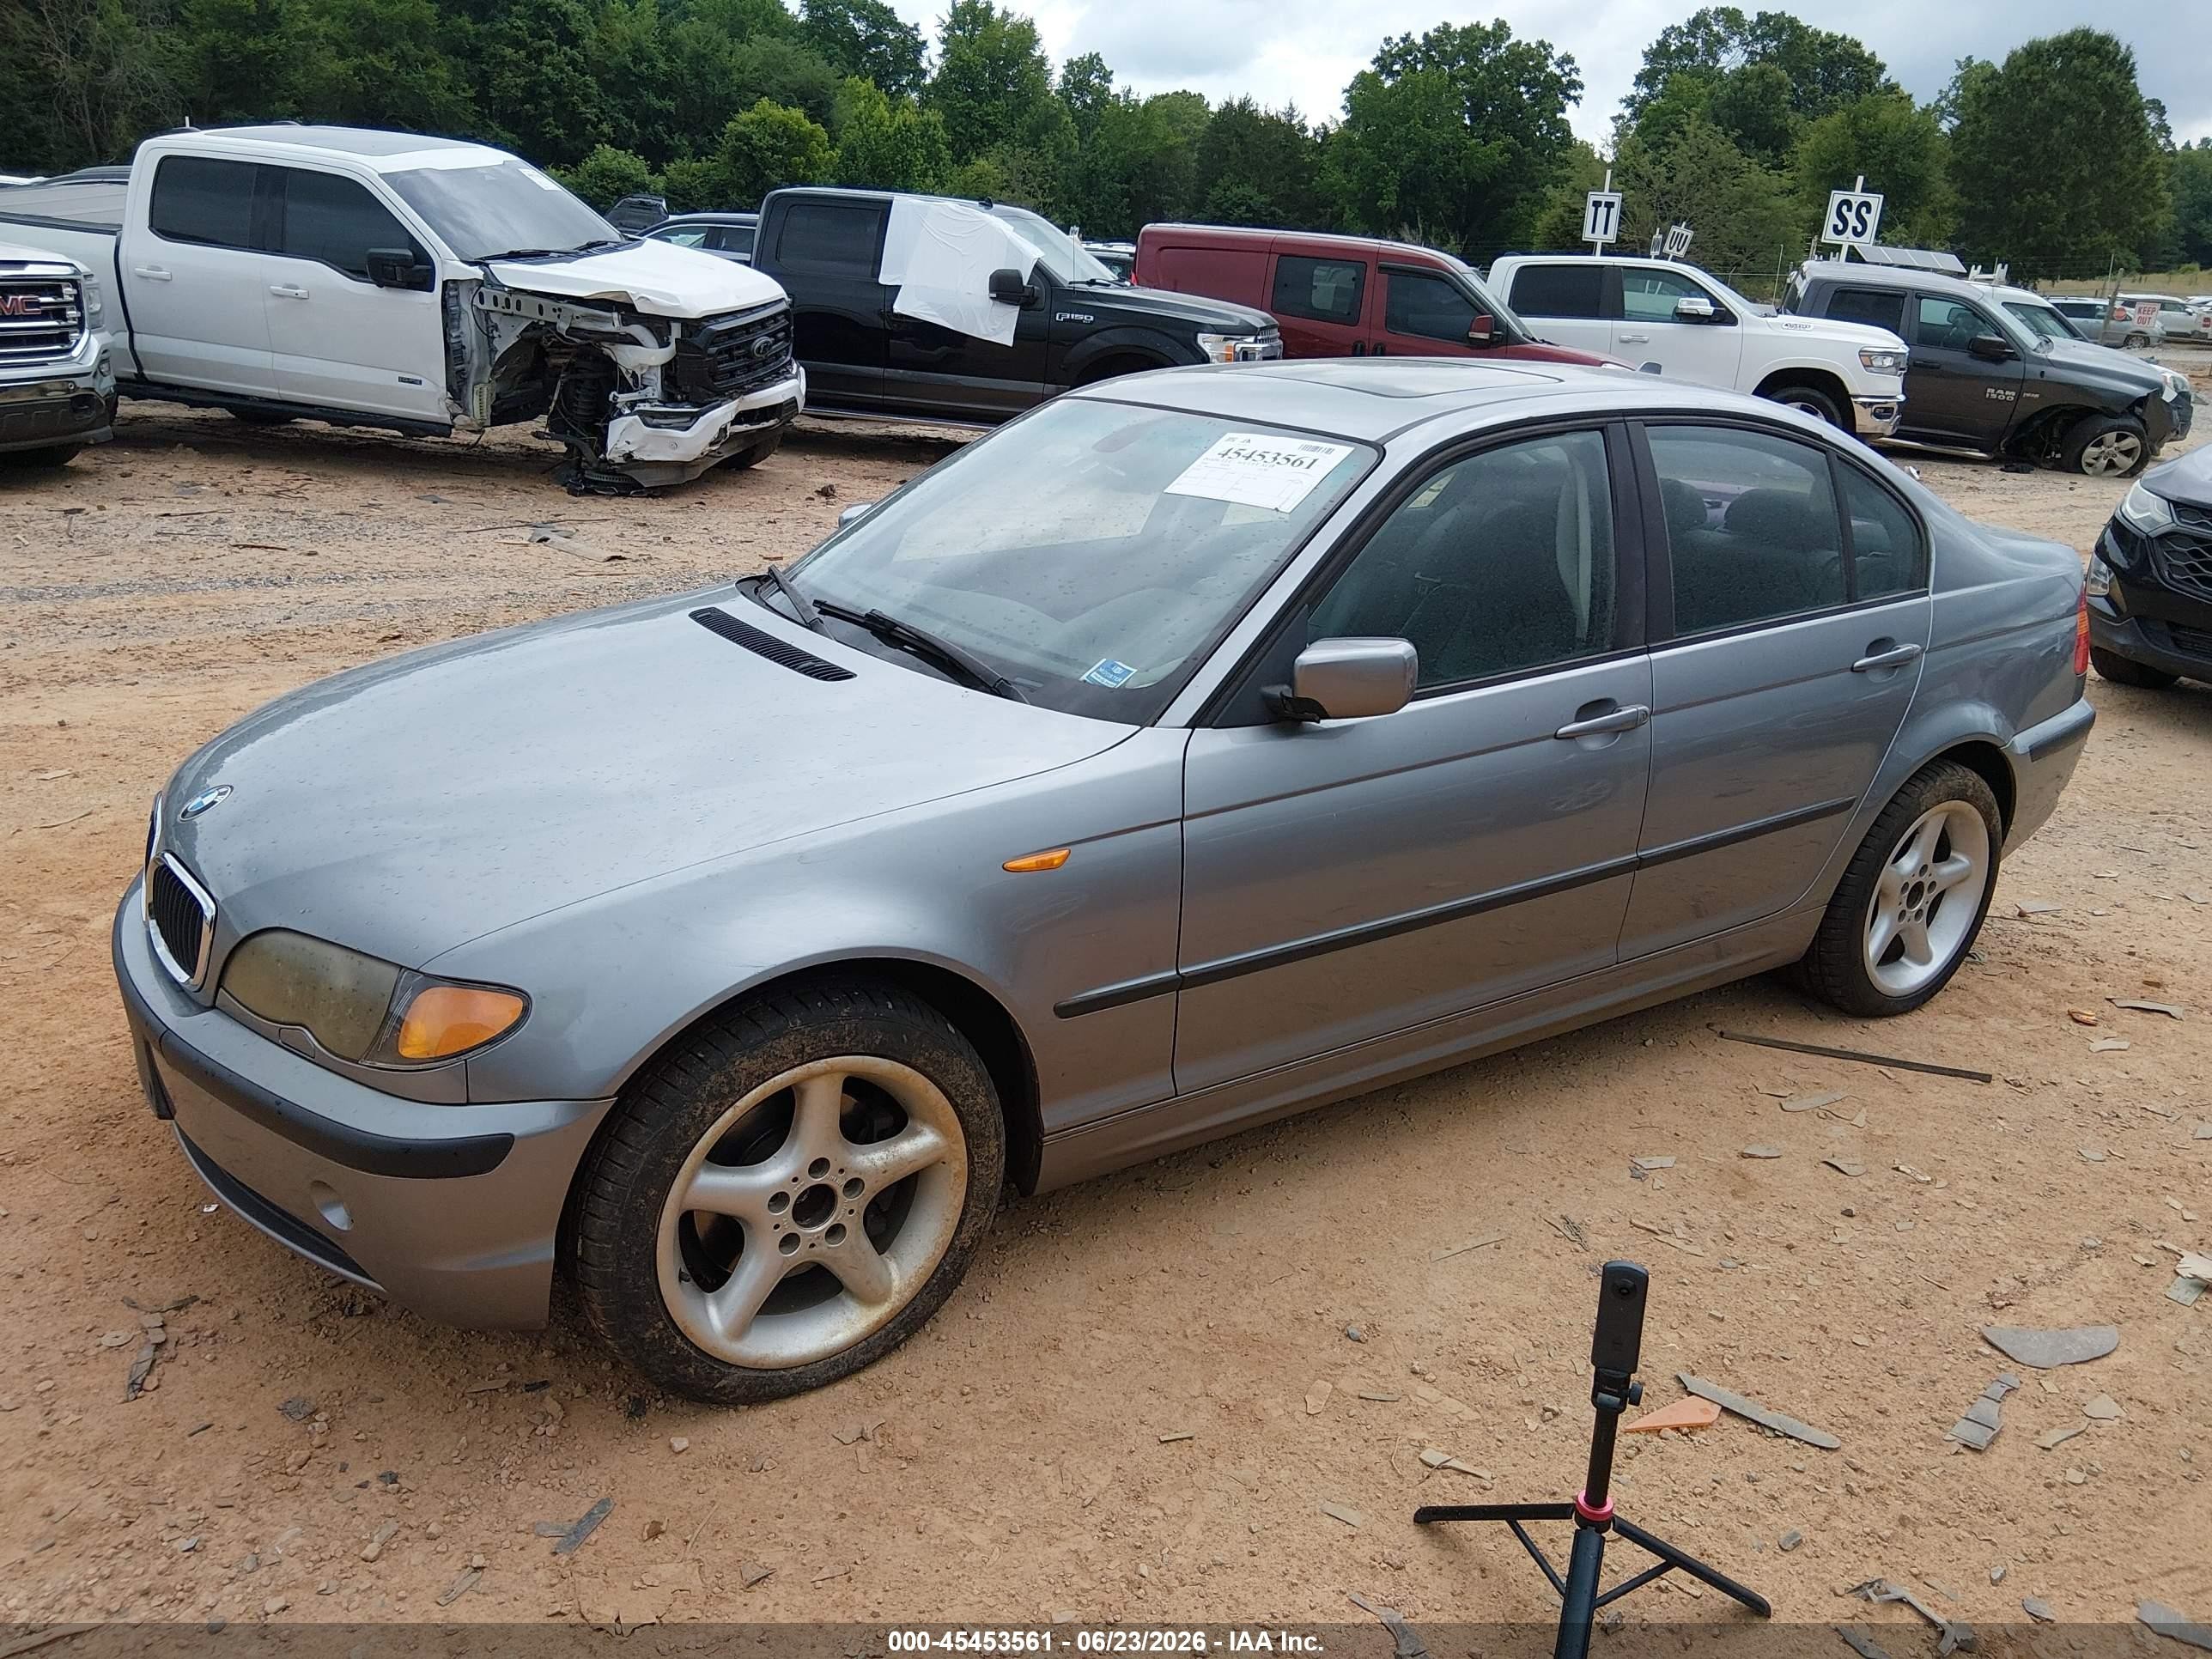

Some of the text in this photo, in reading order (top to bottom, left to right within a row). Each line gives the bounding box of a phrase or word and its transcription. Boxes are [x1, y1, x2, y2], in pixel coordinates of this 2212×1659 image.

[1591, 200, 1615, 235] TT
[1832, 198, 1872, 238] SS
[1668, 230, 1689, 252] UU
[0, 295, 41, 315] MC
[2137, 307, 2156, 315] KEEP
[1985, 392, 2014, 401] 1500
[1218, 447, 1320, 470] 45453561
